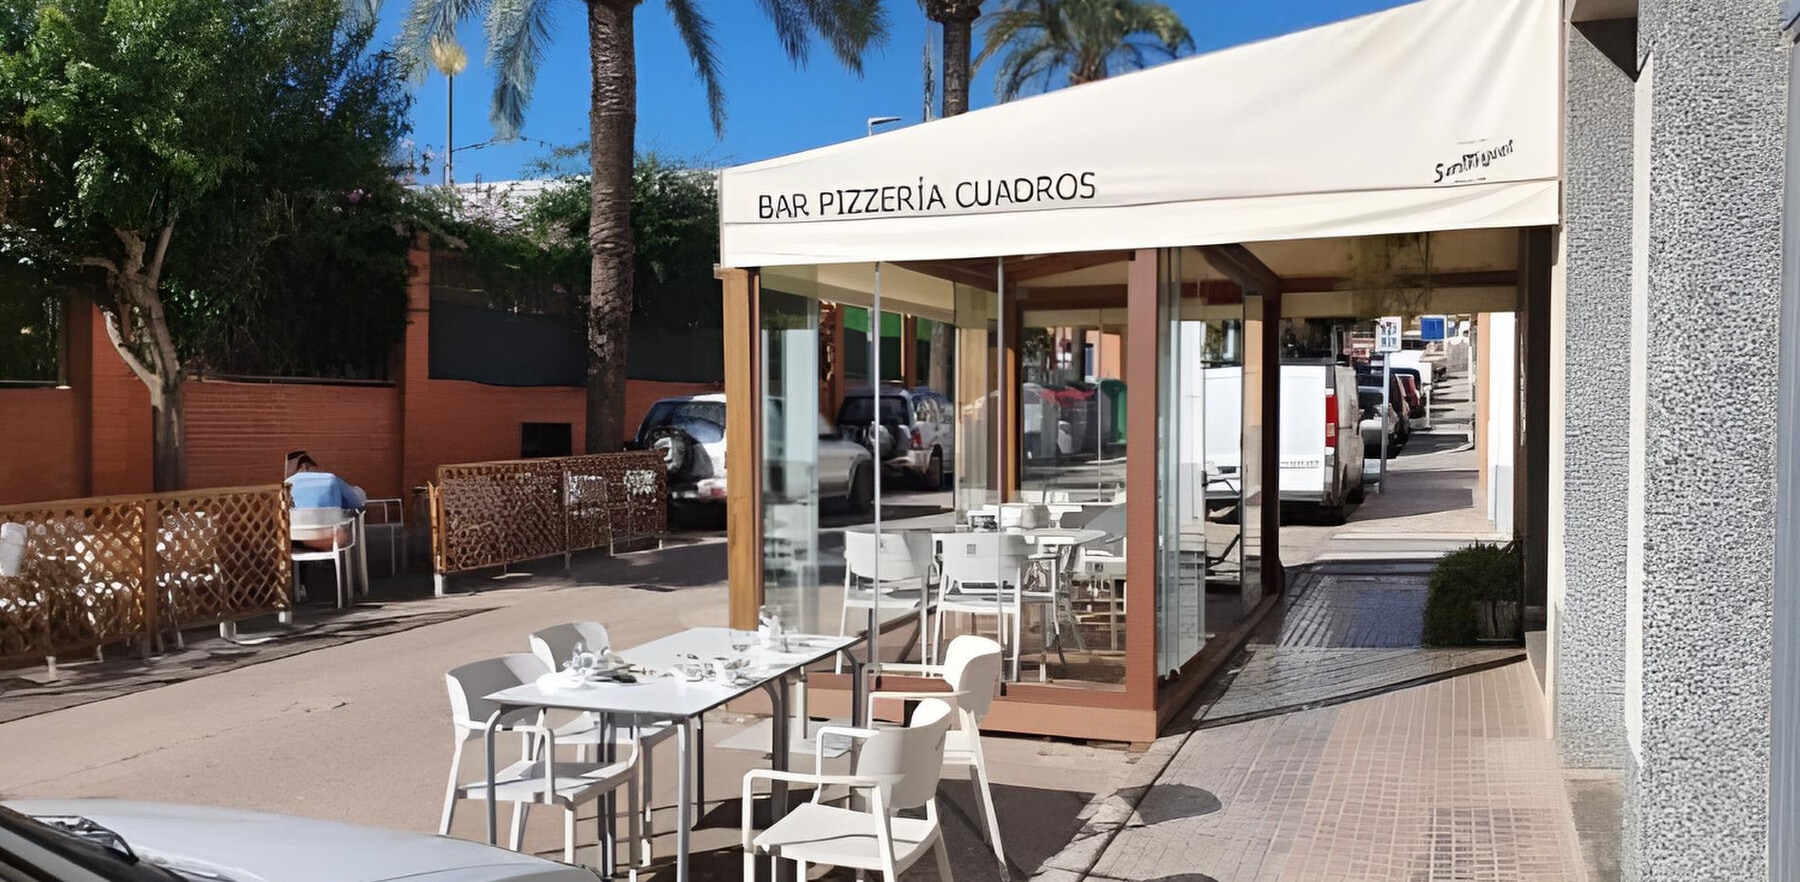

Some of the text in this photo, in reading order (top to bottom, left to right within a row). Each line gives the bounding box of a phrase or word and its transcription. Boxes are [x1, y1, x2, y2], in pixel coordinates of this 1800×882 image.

[759, 171, 1097, 218] BAR PIZZERÍA CUADROS
